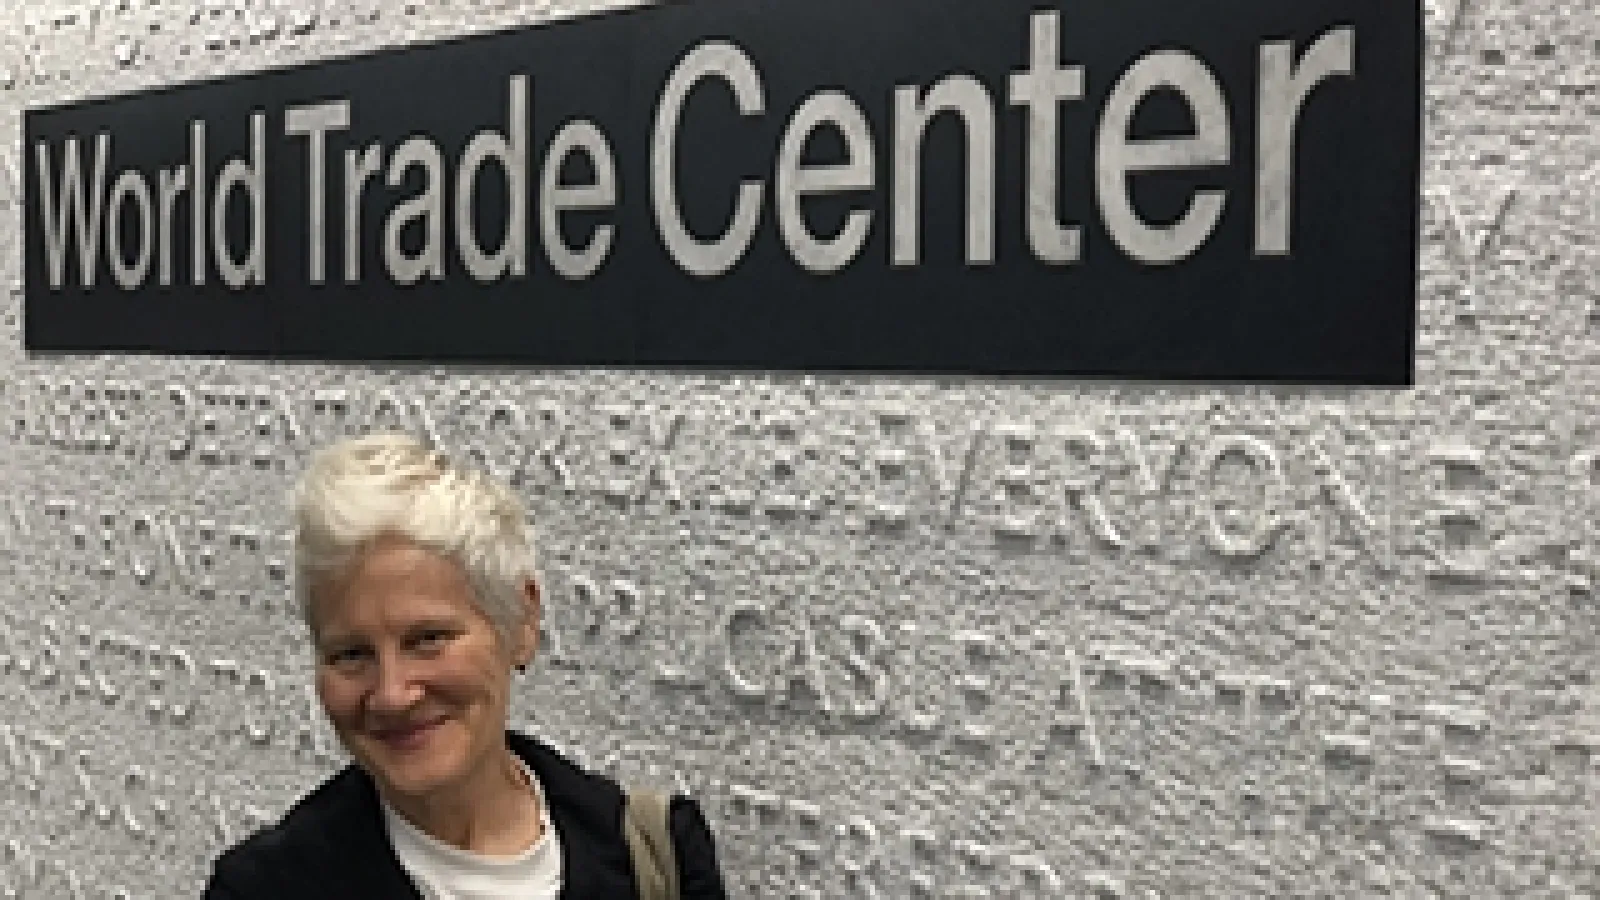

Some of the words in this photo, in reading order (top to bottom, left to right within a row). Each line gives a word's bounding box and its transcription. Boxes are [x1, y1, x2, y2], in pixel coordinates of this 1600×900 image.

[35, 113, 267, 288] World
[284, 75, 617, 283] Trade
[650, 10, 1356, 277] Center
